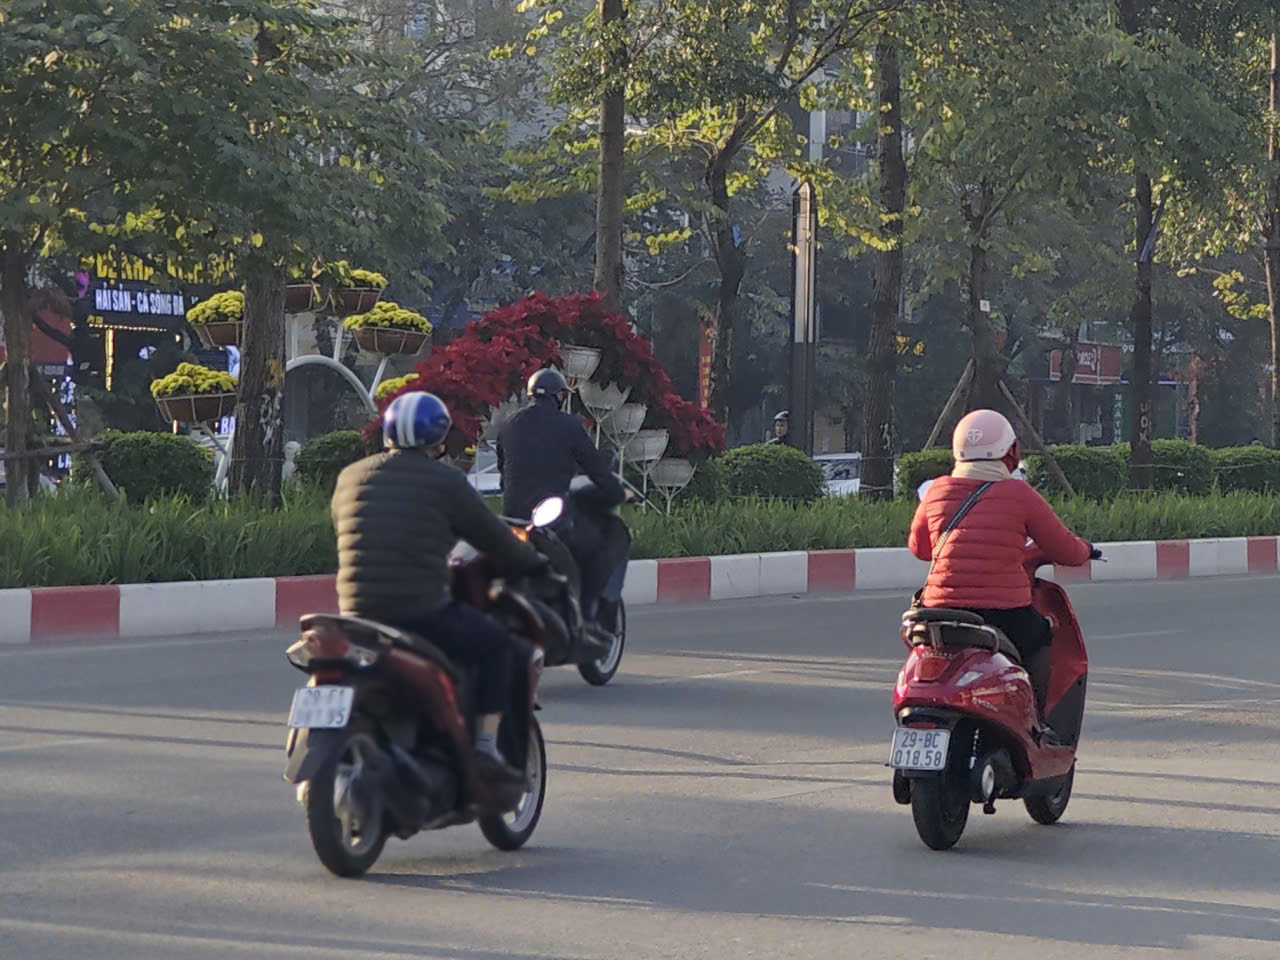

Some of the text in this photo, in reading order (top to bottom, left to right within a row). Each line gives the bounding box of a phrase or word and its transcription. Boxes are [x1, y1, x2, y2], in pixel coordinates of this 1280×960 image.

[95, 281, 112, 311] HẢI
[112, 283, 132, 312] SẢN
[149, 289, 172, 315] SÔNG
[901, 731, 940, 749] 29-BC
[894, 750, 943, 768] 018.58
